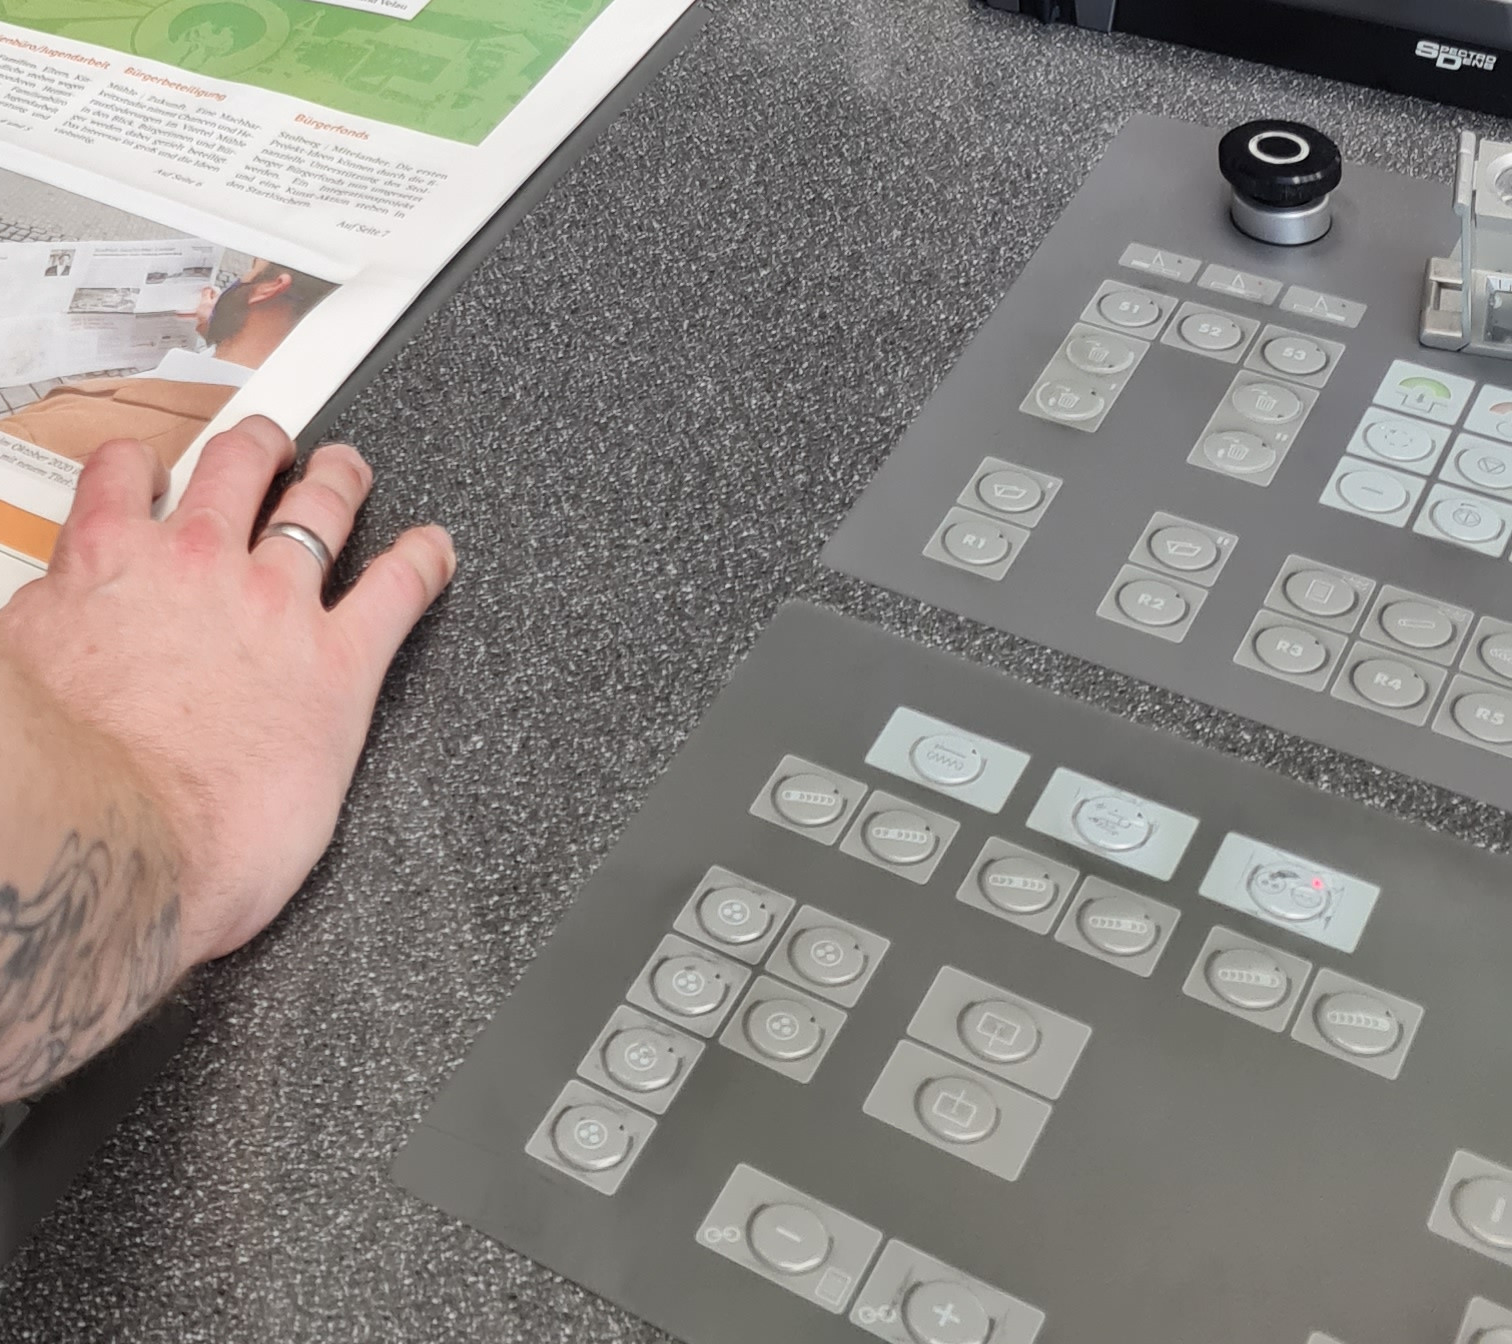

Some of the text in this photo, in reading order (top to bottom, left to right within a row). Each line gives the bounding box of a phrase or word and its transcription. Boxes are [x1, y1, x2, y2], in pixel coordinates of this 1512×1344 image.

[123, 65, 227, 103] Bürgerbeteiligung
[294, 112, 371, 142] Bürgerfonds
[1197, 323, 1222, 337] S2
[962, 534, 985, 550] R1
[1136, 594, 1165, 609] R2
[1275, 640, 1303, 657] R3
[1372, 673, 1402, 691] R4
[1475, 706, 1505, 726] R5
